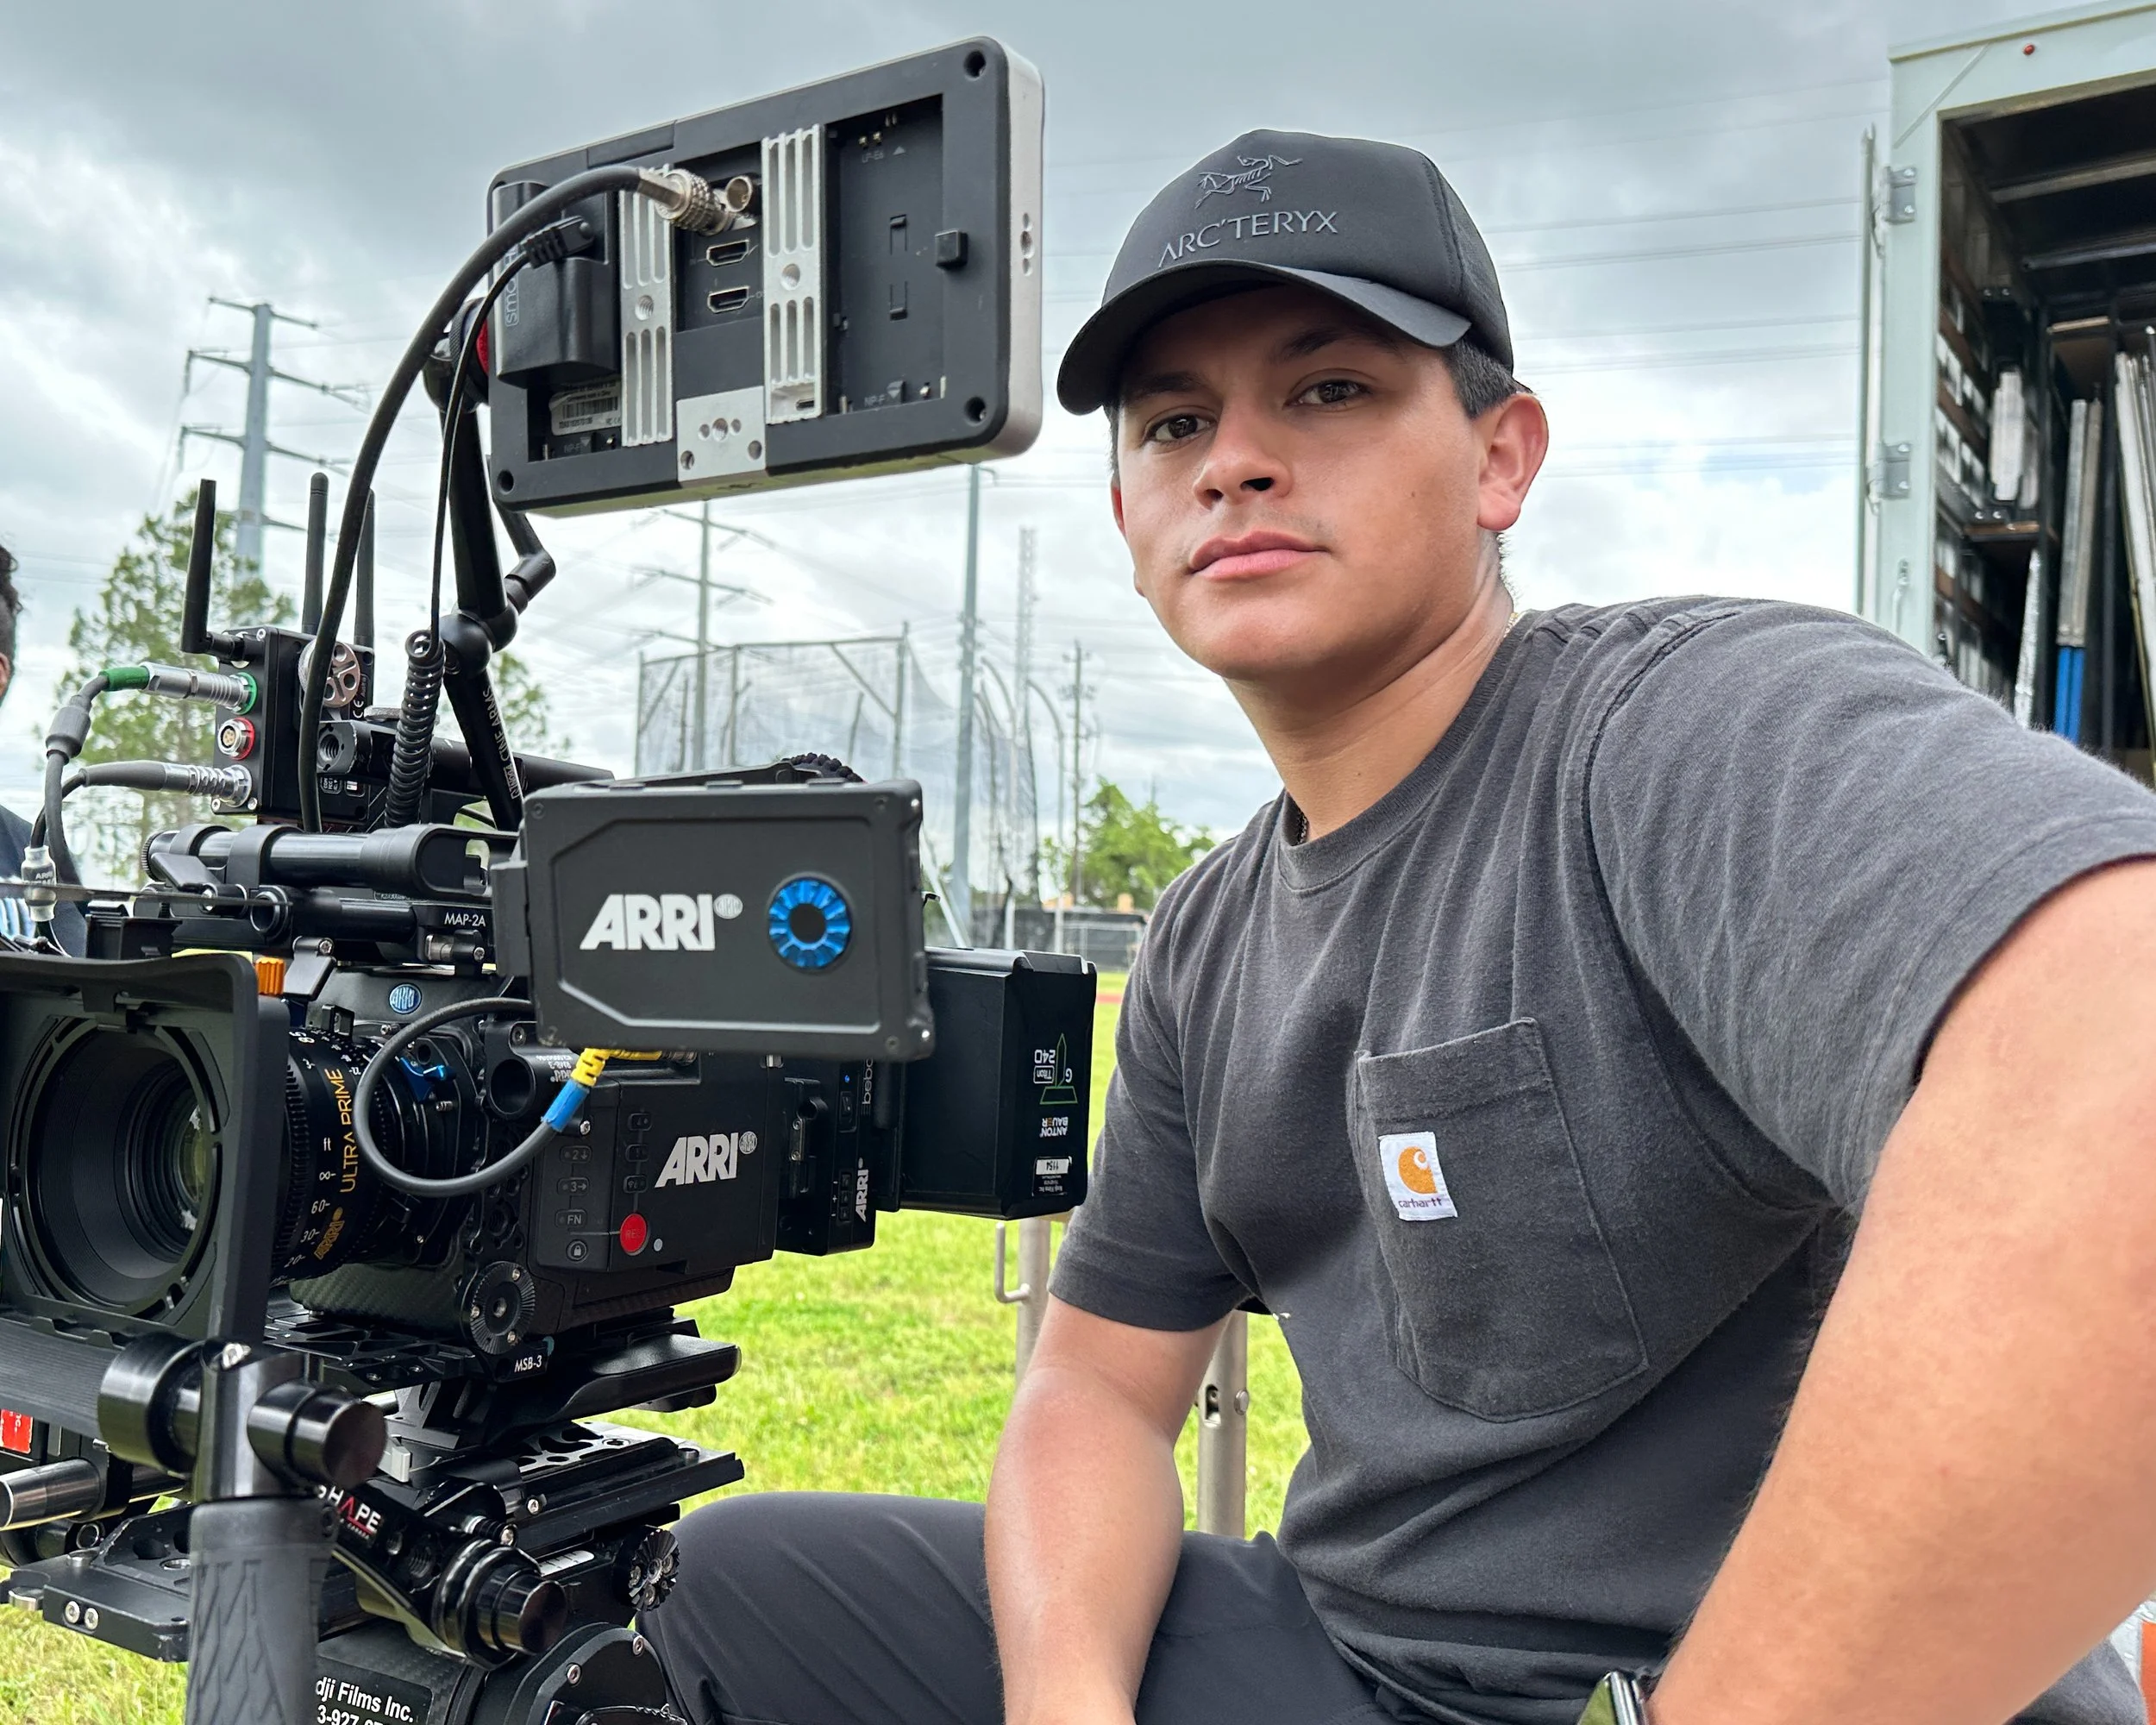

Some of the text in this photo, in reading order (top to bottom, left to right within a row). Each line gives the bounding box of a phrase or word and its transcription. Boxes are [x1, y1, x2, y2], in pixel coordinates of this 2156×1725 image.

[1158, 210, 1338, 268] ARC'TERYX
[483, 685, 501, 726] ARMS
[494, 730, 510, 762] CINE
[444, 912, 486, 927] MAP-2A
[580, 894, 715, 951] ARRI
[324, 1068, 353, 1125] PRIME
[340, 1132, 358, 1192] ULTRA
[655, 1132, 739, 1189] ARRI
[856, 1170, 868, 1222] ARRI
[1398, 1198, 1442, 1208] carhartt
[567, 1214, 582, 1224] FN
[514, 1355, 542, 1372] MSB-3
[337, 1682, 382, 1713] Films
[385, 1696, 414, 1723] Inc.
